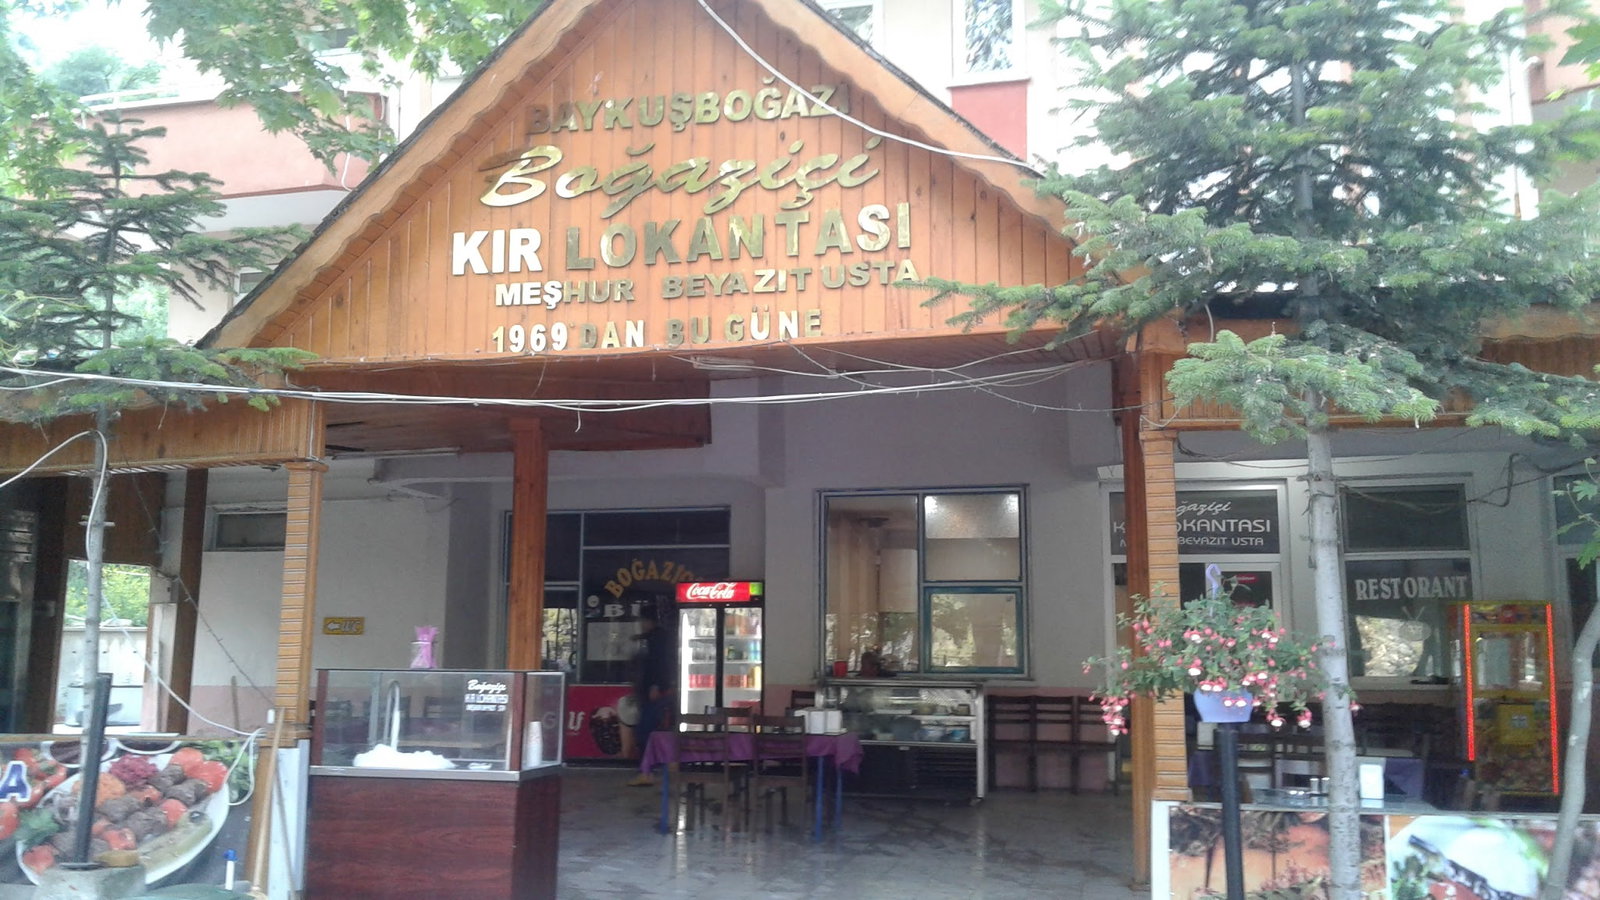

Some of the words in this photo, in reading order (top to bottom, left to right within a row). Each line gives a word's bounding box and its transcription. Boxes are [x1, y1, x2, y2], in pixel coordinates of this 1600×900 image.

[479, 136, 881, 219] Boğaziçi
[452, 228, 543, 275] KIR
[566, 202, 911, 270] LOKANTASI
[495, 279, 634, 309] MEŞHUR
[662, 268, 812, 299] BEYAZIT
[820, 259, 920, 290] USTA
[666, 316, 711, 346] BU
[724, 304, 822, 342] GÜNE
[1176, 500, 1231, 517] ğaziçi
[1231, 537, 1264, 546] USTA
